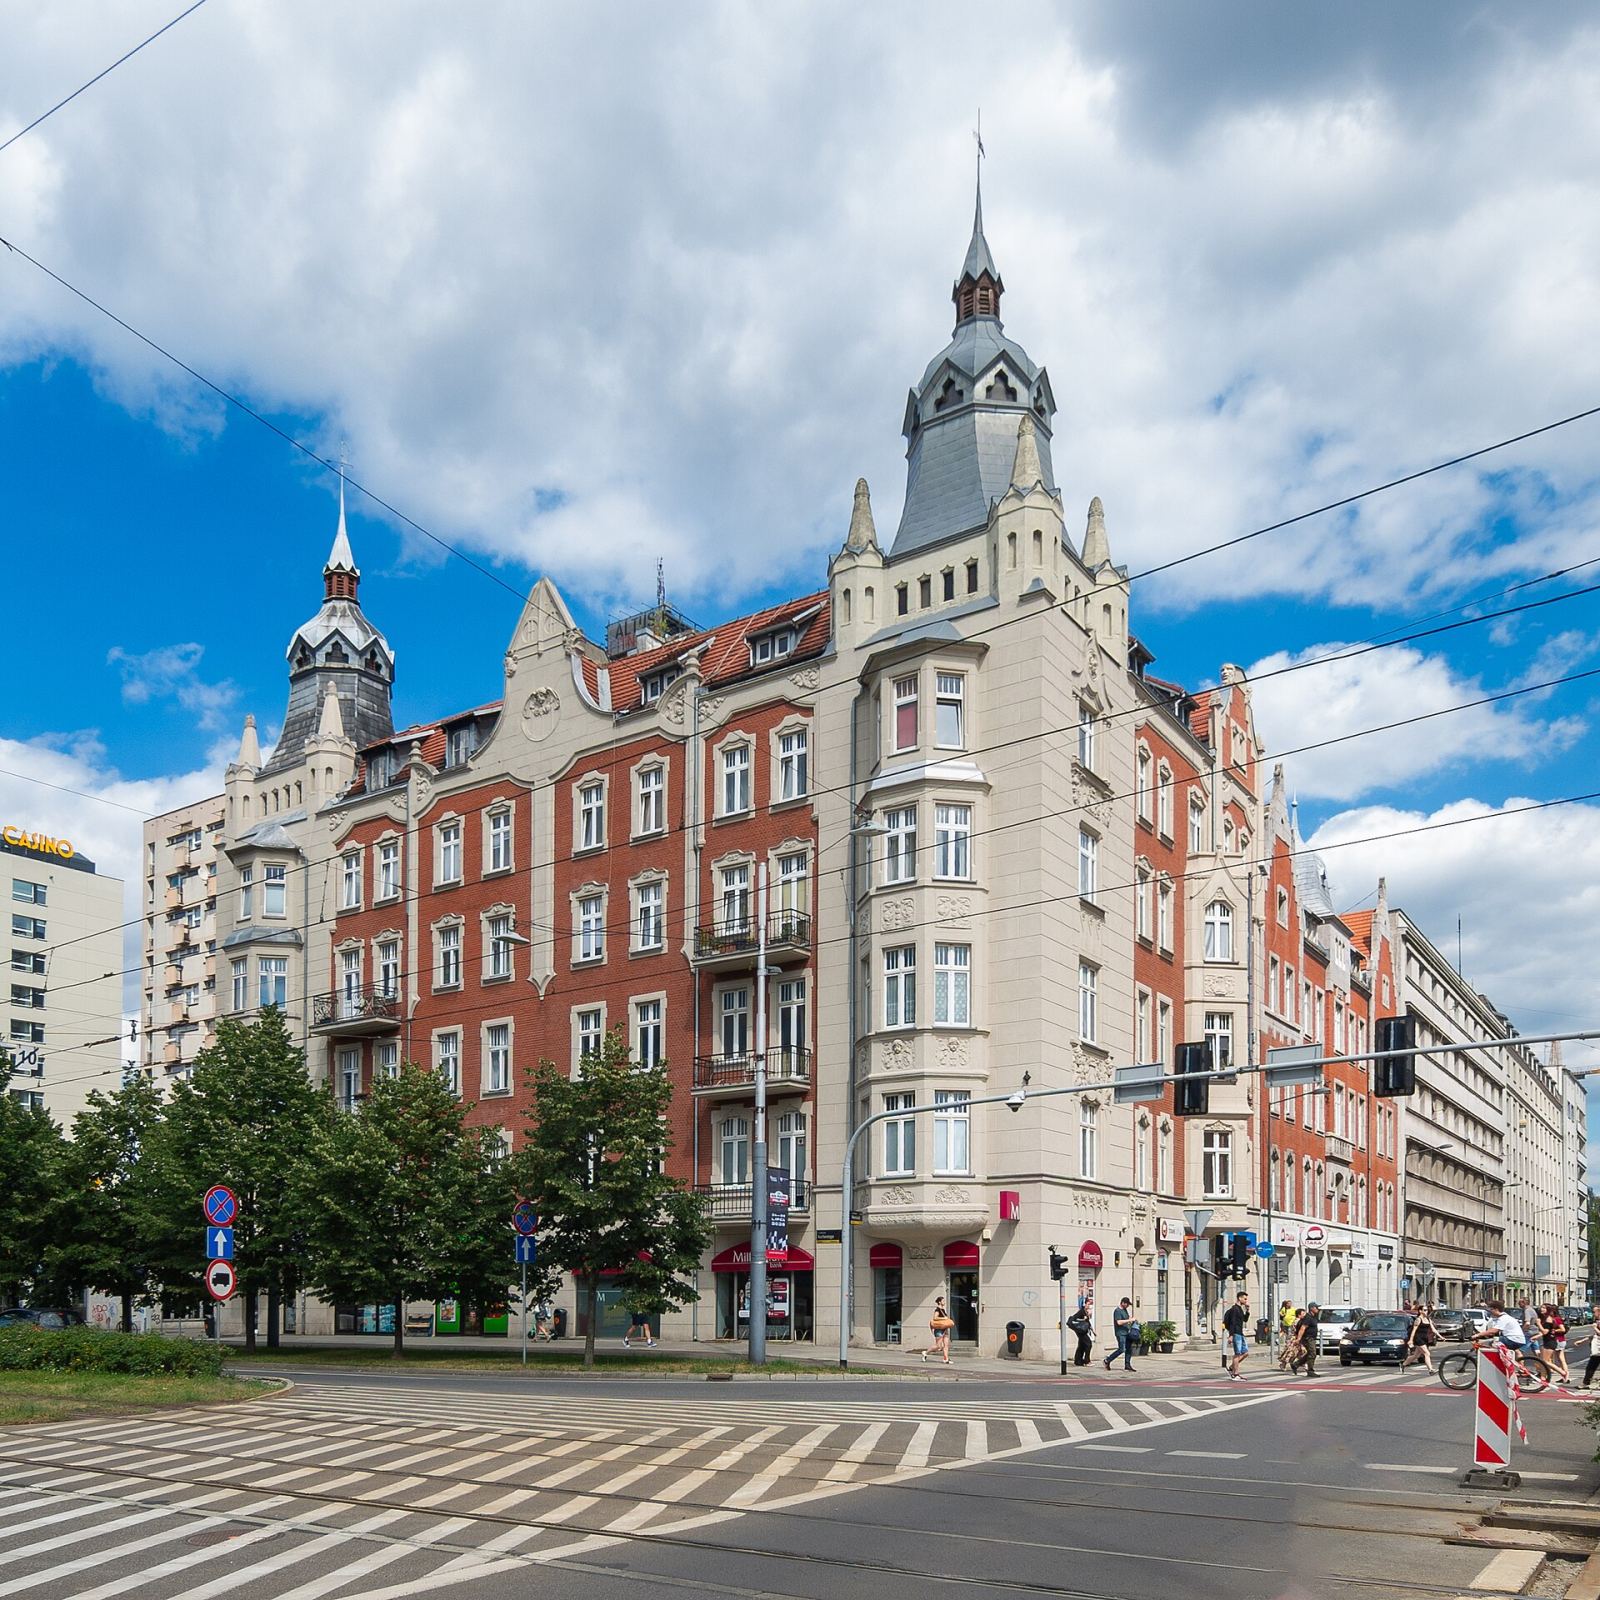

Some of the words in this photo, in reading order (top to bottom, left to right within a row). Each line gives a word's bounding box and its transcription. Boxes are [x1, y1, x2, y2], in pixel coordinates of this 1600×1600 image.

[3, 825, 75, 858] CASINO
[18, 1050, 37, 1065] 10
[1010, 1200, 1019, 1220] M
[597, 1291, 605, 1302] M
